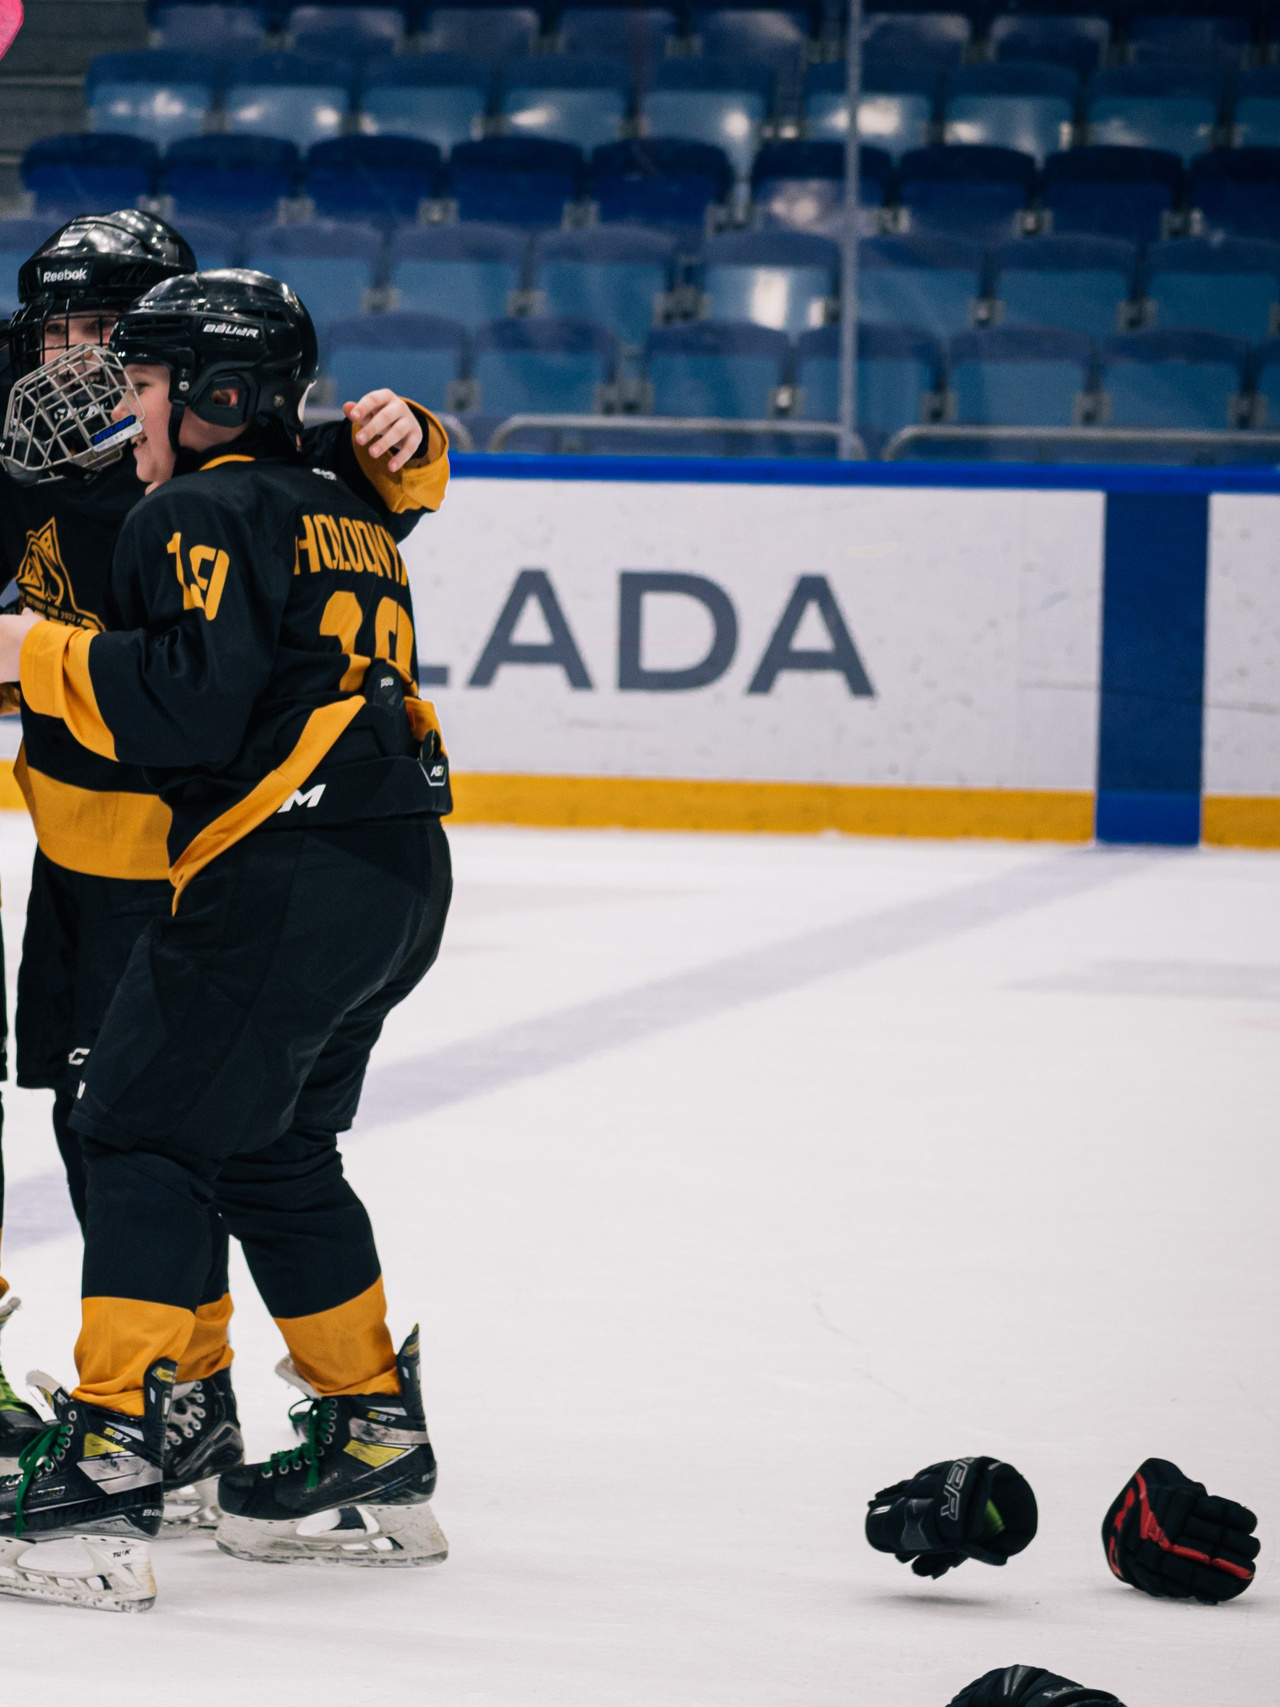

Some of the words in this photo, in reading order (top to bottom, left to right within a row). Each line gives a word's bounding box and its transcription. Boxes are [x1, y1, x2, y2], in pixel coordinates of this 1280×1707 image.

[43, 267, 88, 283] Reebok
[203, 323, 259, 339] BAUER
[166, 532, 230, 621] 19
